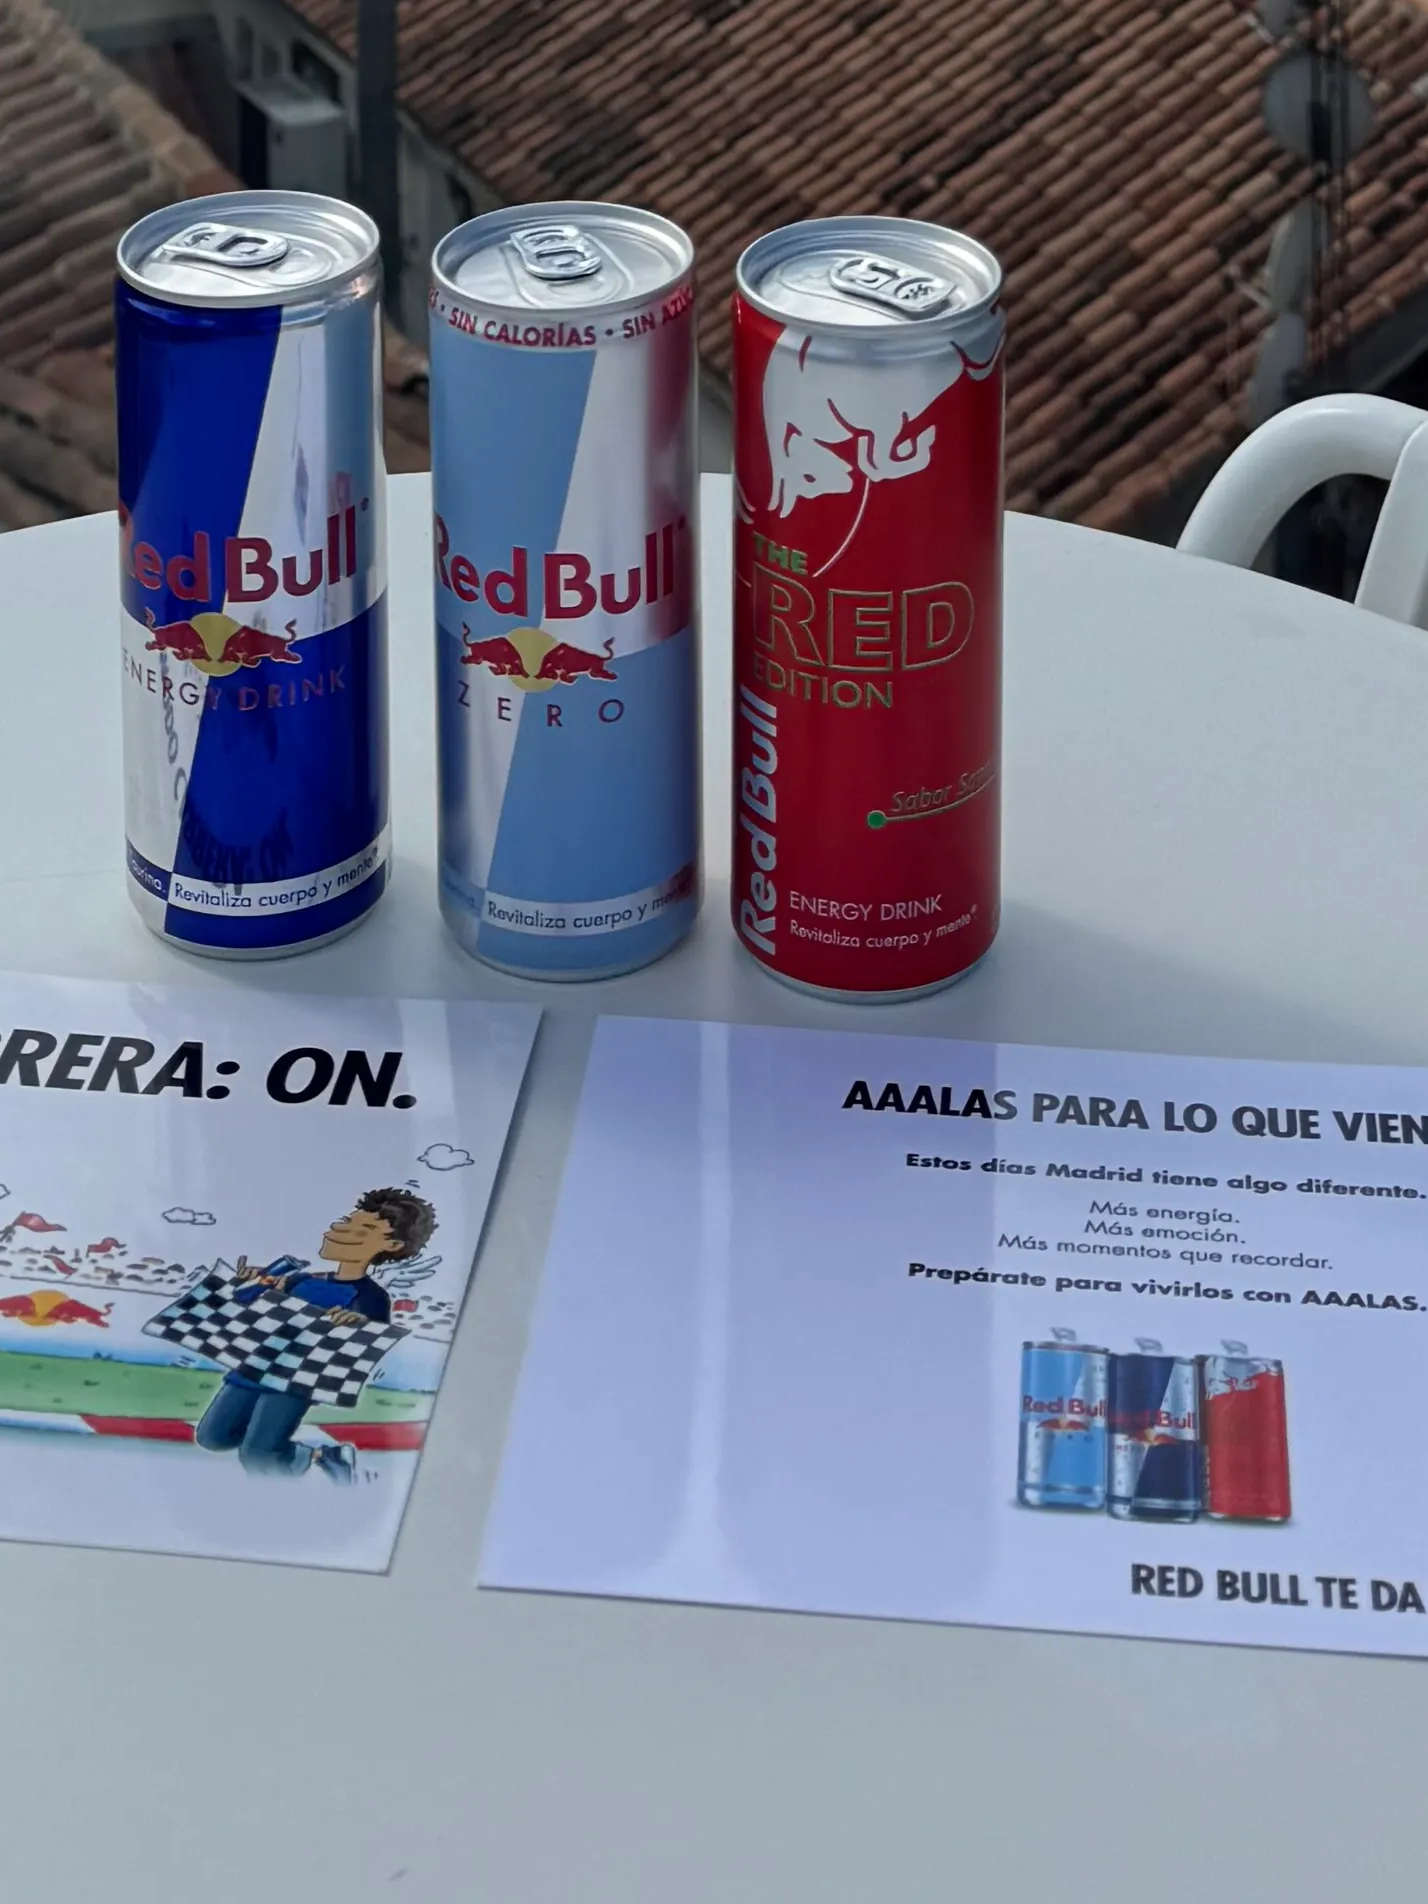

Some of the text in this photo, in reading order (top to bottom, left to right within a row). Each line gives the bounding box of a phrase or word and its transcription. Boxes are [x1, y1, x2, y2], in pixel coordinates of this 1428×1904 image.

[448, 306, 477, 335] SIN
[483, 320, 597, 347] CALORÍAS
[623, 312, 656, 339] SIN
[224, 505, 357, 603] Bull
[543, 523, 673, 621] Bull
[752, 529, 809, 576] THE
[753, 560, 975, 672] RED
[123, 647, 346, 712] ENERGY DRINK
[457, 678, 625, 727] ZERO
[753, 649, 893, 709] EDITION
[739, 685, 779, 957] Red Bull
[889, 784, 953, 813] Sabor
[174, 881, 252, 908] Revitaliza
[258, 884, 318, 908] cuerpo
[321, 878, 333, 894] y
[487, 899, 567, 930] Revitaliza
[572, 908, 632, 930] cuerpo
[637, 902, 648, 922] y
[788, 889, 943, 922] ENERGY DRINK
[790, 918, 861, 948] Revitaliza
[865, 932, 919, 950] cuerpo
[923, 930, 933, 947] y
[265, 1046, 418, 1110] ON.
[841, 1079, 1019, 1121] AAALAS
[1031, 1092, 1150, 1130] PARA
[1163, 1101, 1218, 1134] LO
[1231, 1105, 1322, 1140] QUE
[905, 1152, 1428, 1200] Estos días Madrid tiene algo diferente.
[1083, 1219, 1247, 1245] Más emoción.
[1088, 1200, 1241, 1226] Más energía.
[997, 1233, 1335, 1271] Más momentos que recordar.
[907, 1262, 1428, 1313] Prepárate para vivirlos con AAALAS.
[1130, 1563, 1204, 1599] RED
[1216, 1568, 1309, 1607] BULL
[1314, 1575, 1360, 1611] TE
[1370, 1578, 1427, 1615] DA
